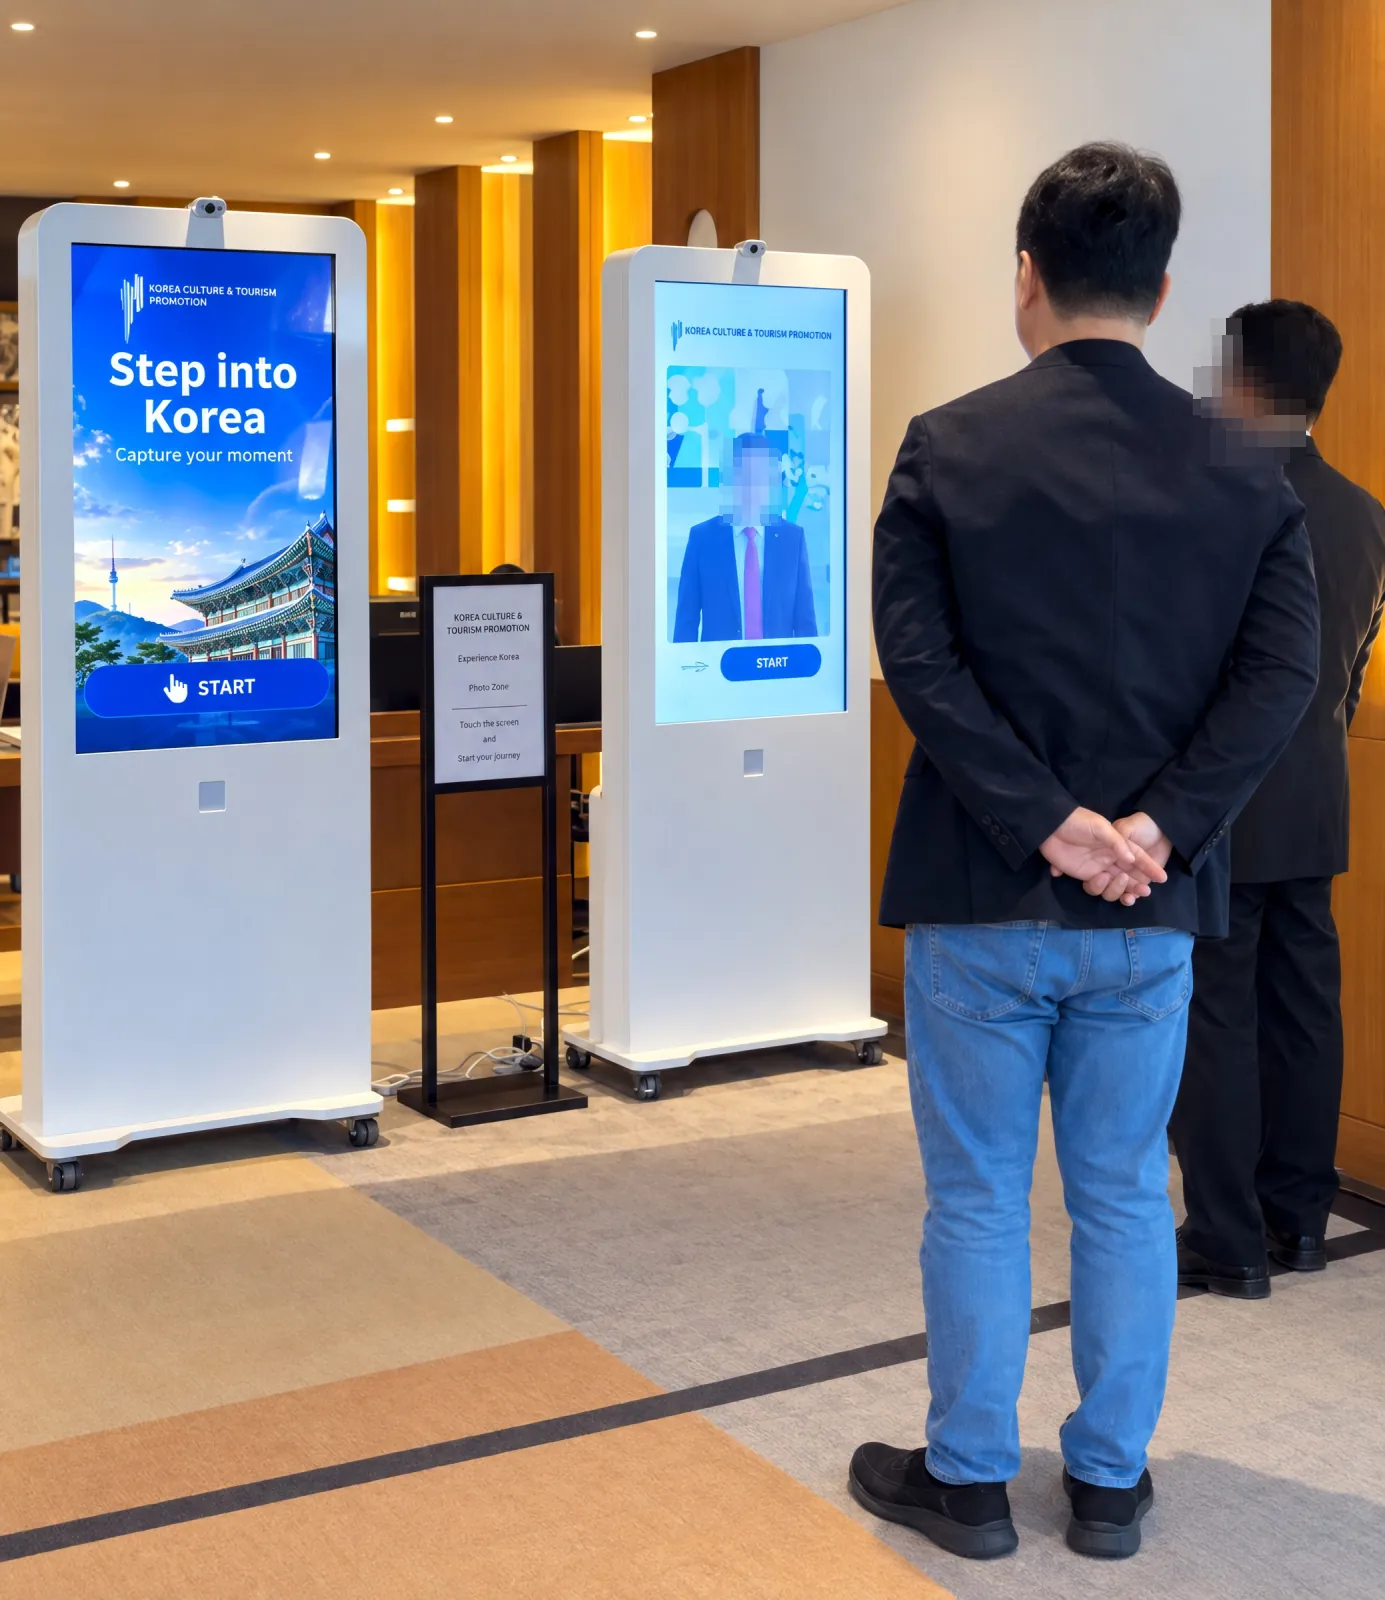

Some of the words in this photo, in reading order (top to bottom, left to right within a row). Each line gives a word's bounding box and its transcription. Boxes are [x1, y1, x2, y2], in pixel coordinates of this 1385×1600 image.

[149, 284, 180, 294] KOREA
[183, 285, 224, 295] CULTURE
[227, 287, 233, 295] &
[235, 287, 276, 296] TOURISM
[150, 297, 207, 306] PROMOTION
[685, 327, 710, 335] KOREA
[713, 328, 746, 336] CULTURE
[754, 329, 787, 338] TOURISM
[789, 330, 832, 339] PROMOTION
[109, 351, 206, 396] Step
[217, 352, 297, 390] into
[145, 399, 266, 434] Korea
[116, 447, 181, 464] Capture
[186, 449, 222, 465] your
[227, 449, 293, 462] moment
[454, 613, 480, 621] KOREA
[482, 612, 515, 620] CULTURE
[447, 625, 482, 634] TOURISM
[484, 624, 530, 633] PROMOTION
[458, 654, 497, 663] Experience
[757, 657, 788, 668] START
[198, 679, 256, 695] START
[496, 719, 519, 727] screen
[483, 735, 496, 743] and
[476, 754, 492, 762] your
[494, 752, 520, 760] journey
